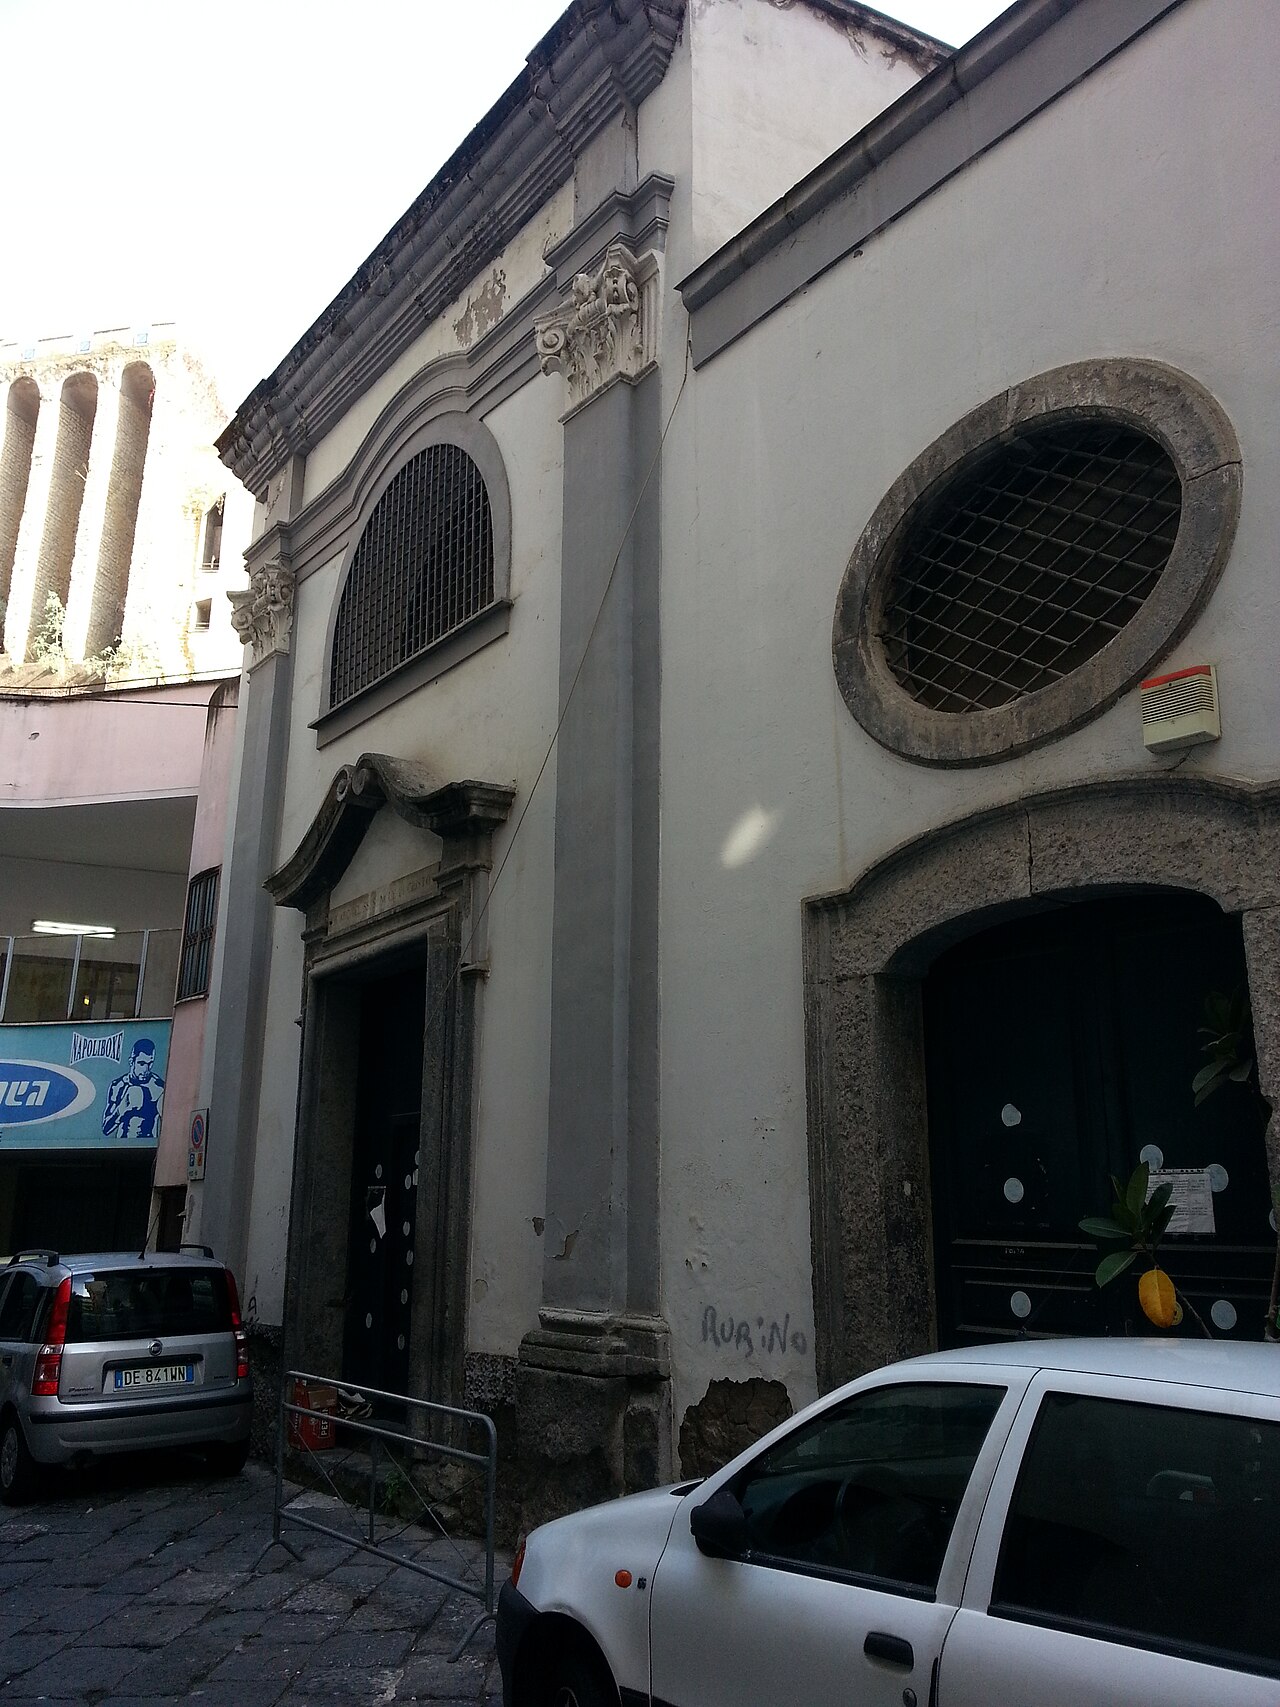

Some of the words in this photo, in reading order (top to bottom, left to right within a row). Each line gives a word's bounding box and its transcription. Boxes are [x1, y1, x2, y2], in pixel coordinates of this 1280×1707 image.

[70, 1033, 123, 1064] NAPOLIBOXE
[124, 1370, 141, 1386] DE
[145, 1366, 186, 1383] 841WN
